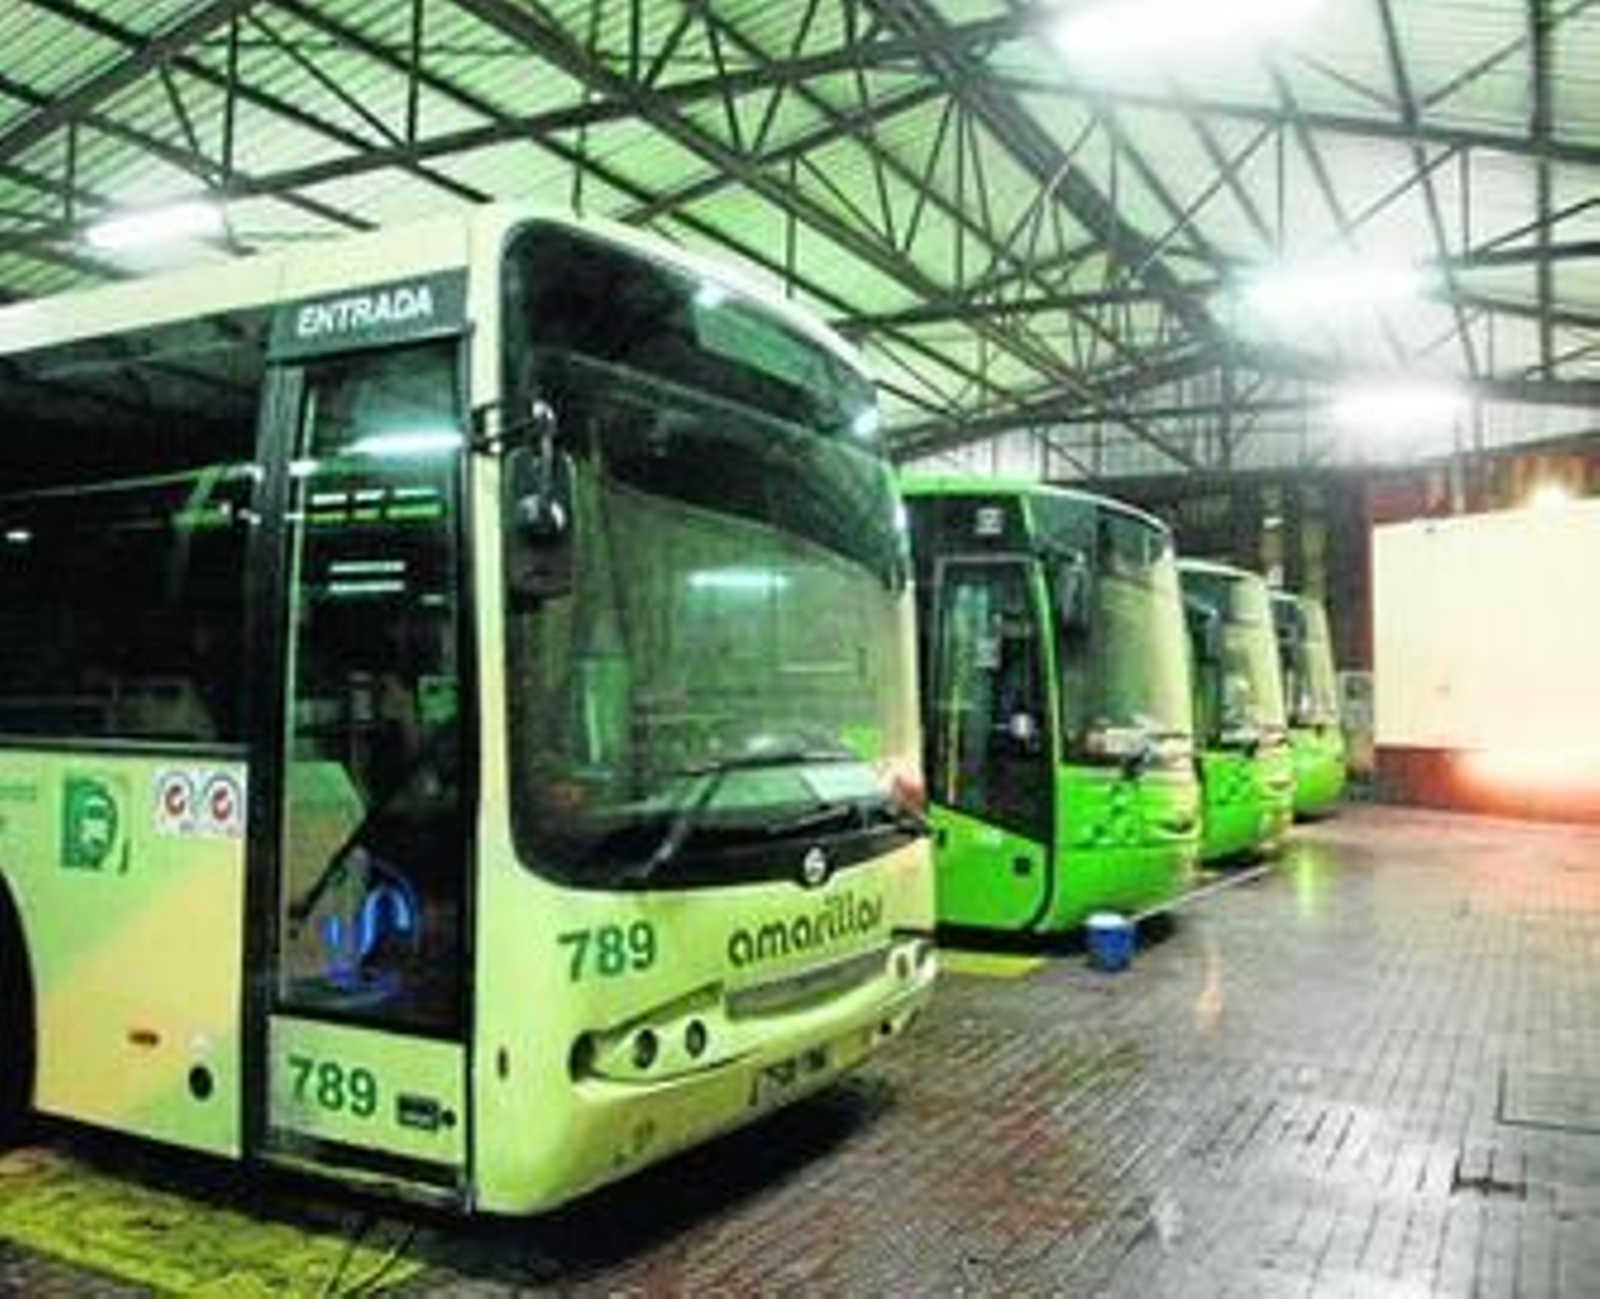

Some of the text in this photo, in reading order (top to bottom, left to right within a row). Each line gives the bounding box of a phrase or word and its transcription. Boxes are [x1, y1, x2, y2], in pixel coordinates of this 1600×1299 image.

[297, 285, 434, 338] ENTRADA
[556, 921, 656, 982] 789
[288, 1054, 377, 1118] 789
